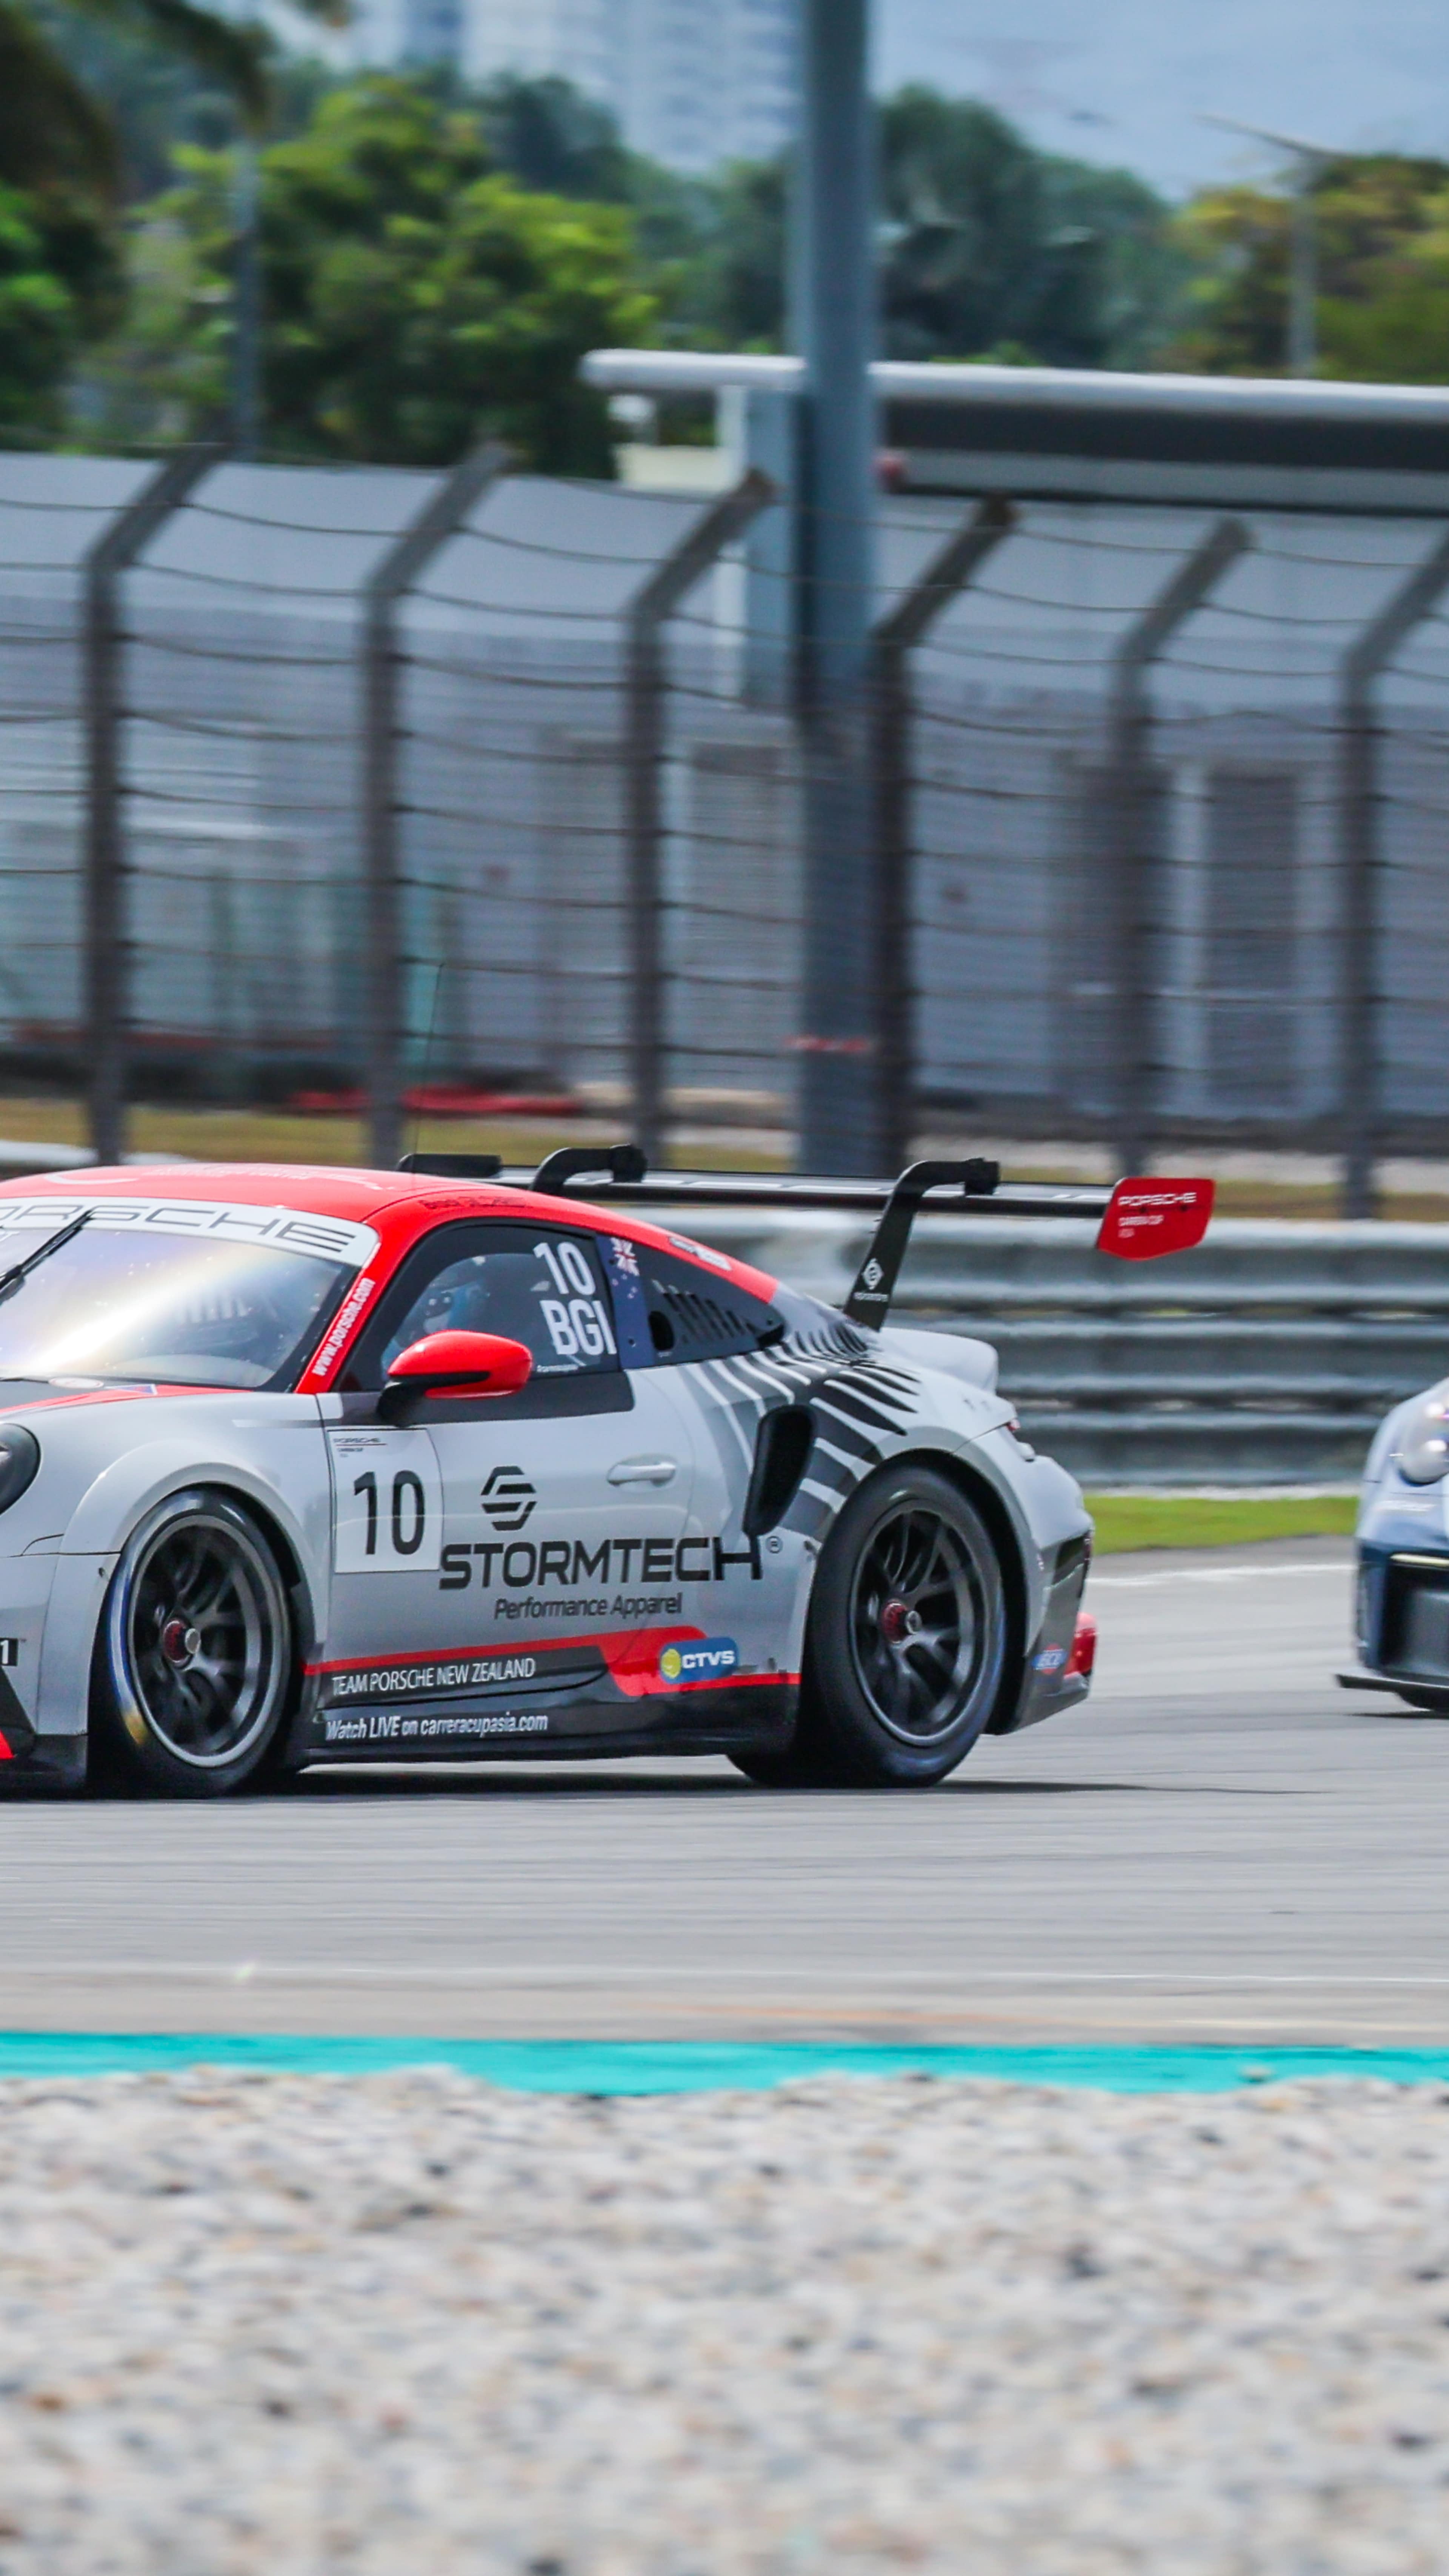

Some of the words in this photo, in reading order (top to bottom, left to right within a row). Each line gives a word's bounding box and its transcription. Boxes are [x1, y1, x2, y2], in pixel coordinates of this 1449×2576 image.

[1118, 1192, 1197, 1206] PORSCHE
[533, 1242, 596, 1295] 10
[312, 1278, 376, 1376] www.porsche.com
[540, 1300, 617, 1355] BGI
[353, 1470, 425, 1555] 10
[439, 1537, 763, 1590] STORMTECH
[494, 1595, 607, 1619] Performance
[610, 1592, 683, 1619] Apparel
[332, 1675, 369, 1696] TEAM
[370, 1668, 434, 1692] PORSCHE
[437, 1665, 469, 1685] NEW
[471, 1658, 536, 1682] ZEALAND
[681, 1650, 734, 1669] CTVS
[325, 1718, 367, 1741] Watch
[370, 1715, 401, 1738] LIVE
[401, 1721, 417, 1736] on
[420, 1711, 548, 1738] carreracupasia.com
